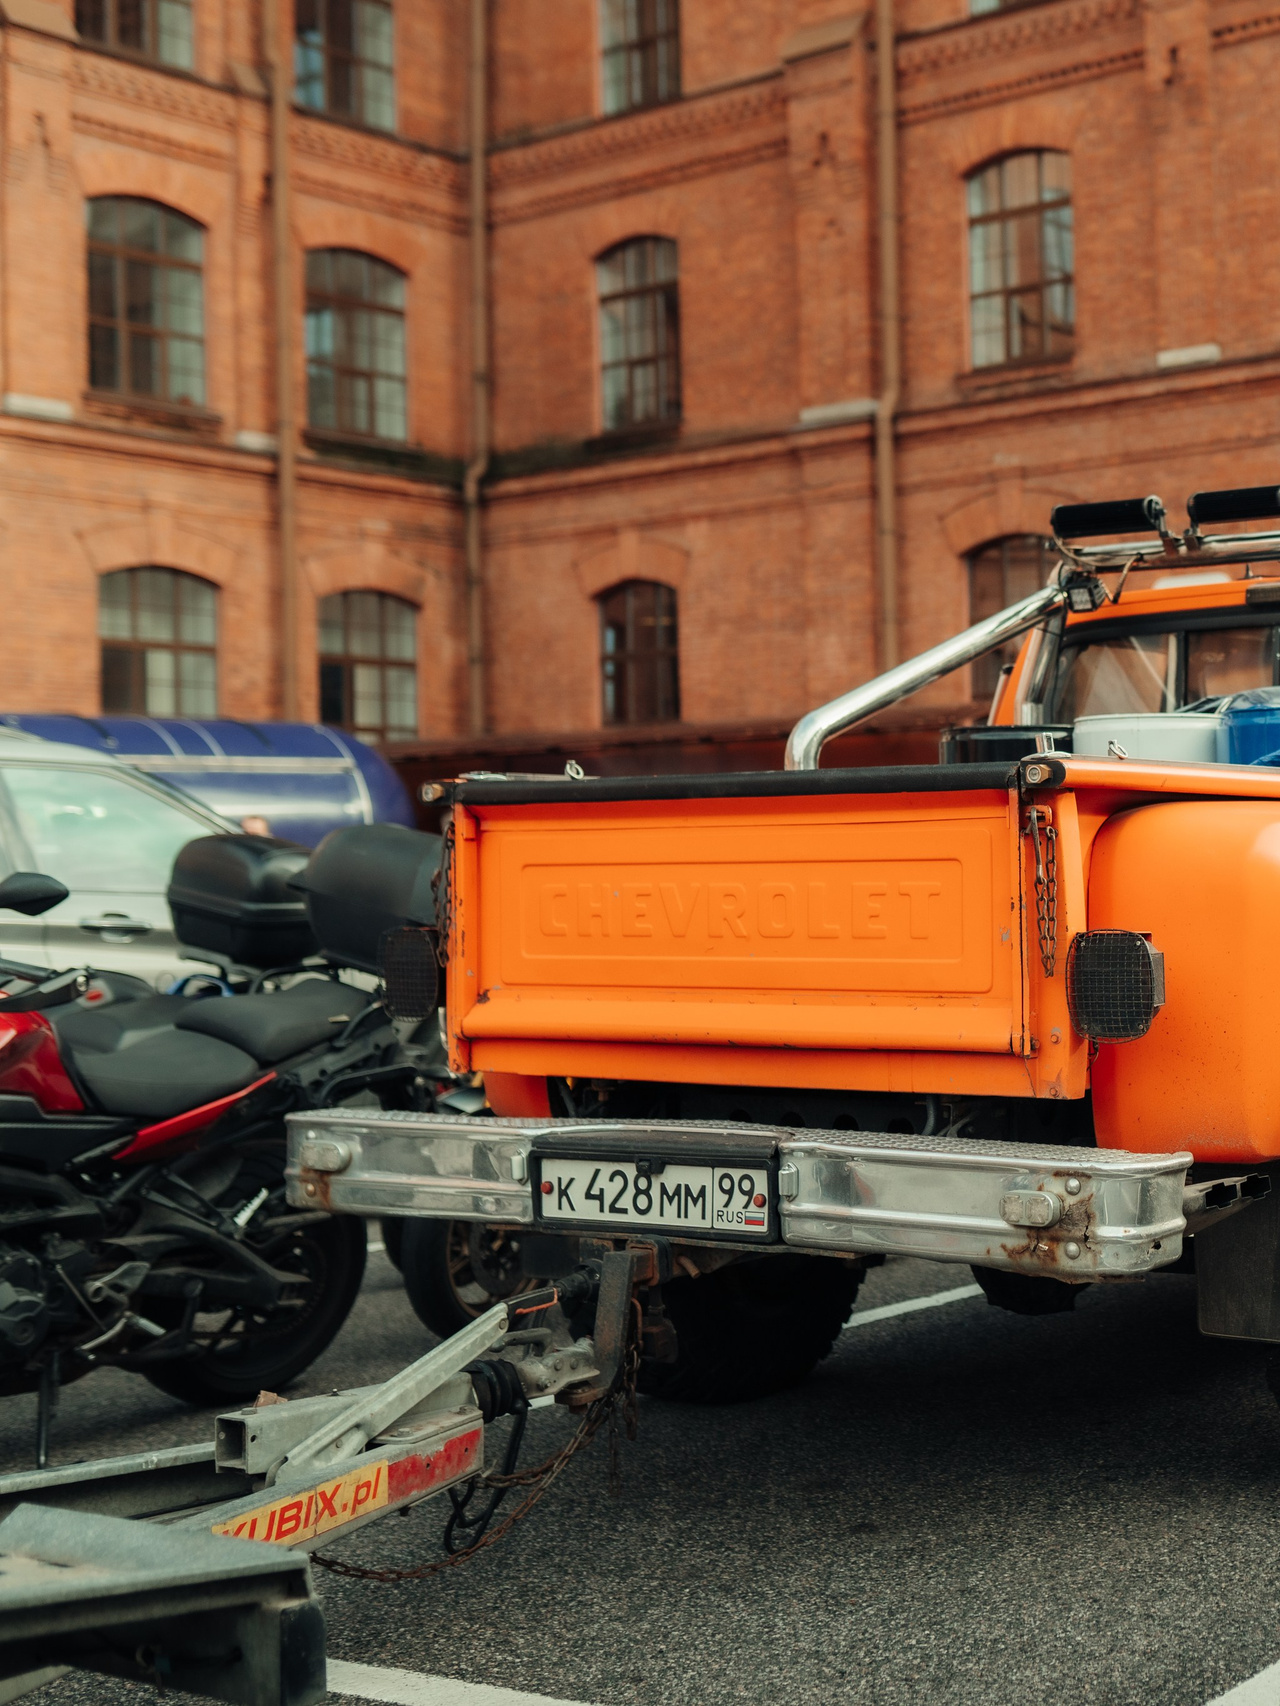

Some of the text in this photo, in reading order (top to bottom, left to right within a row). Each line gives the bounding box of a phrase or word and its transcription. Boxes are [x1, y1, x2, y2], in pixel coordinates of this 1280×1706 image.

[540, 881, 942, 940] CHEVROLET
[718, 1172, 756, 1210] 99
[716, 1209, 744, 1224] RUS
